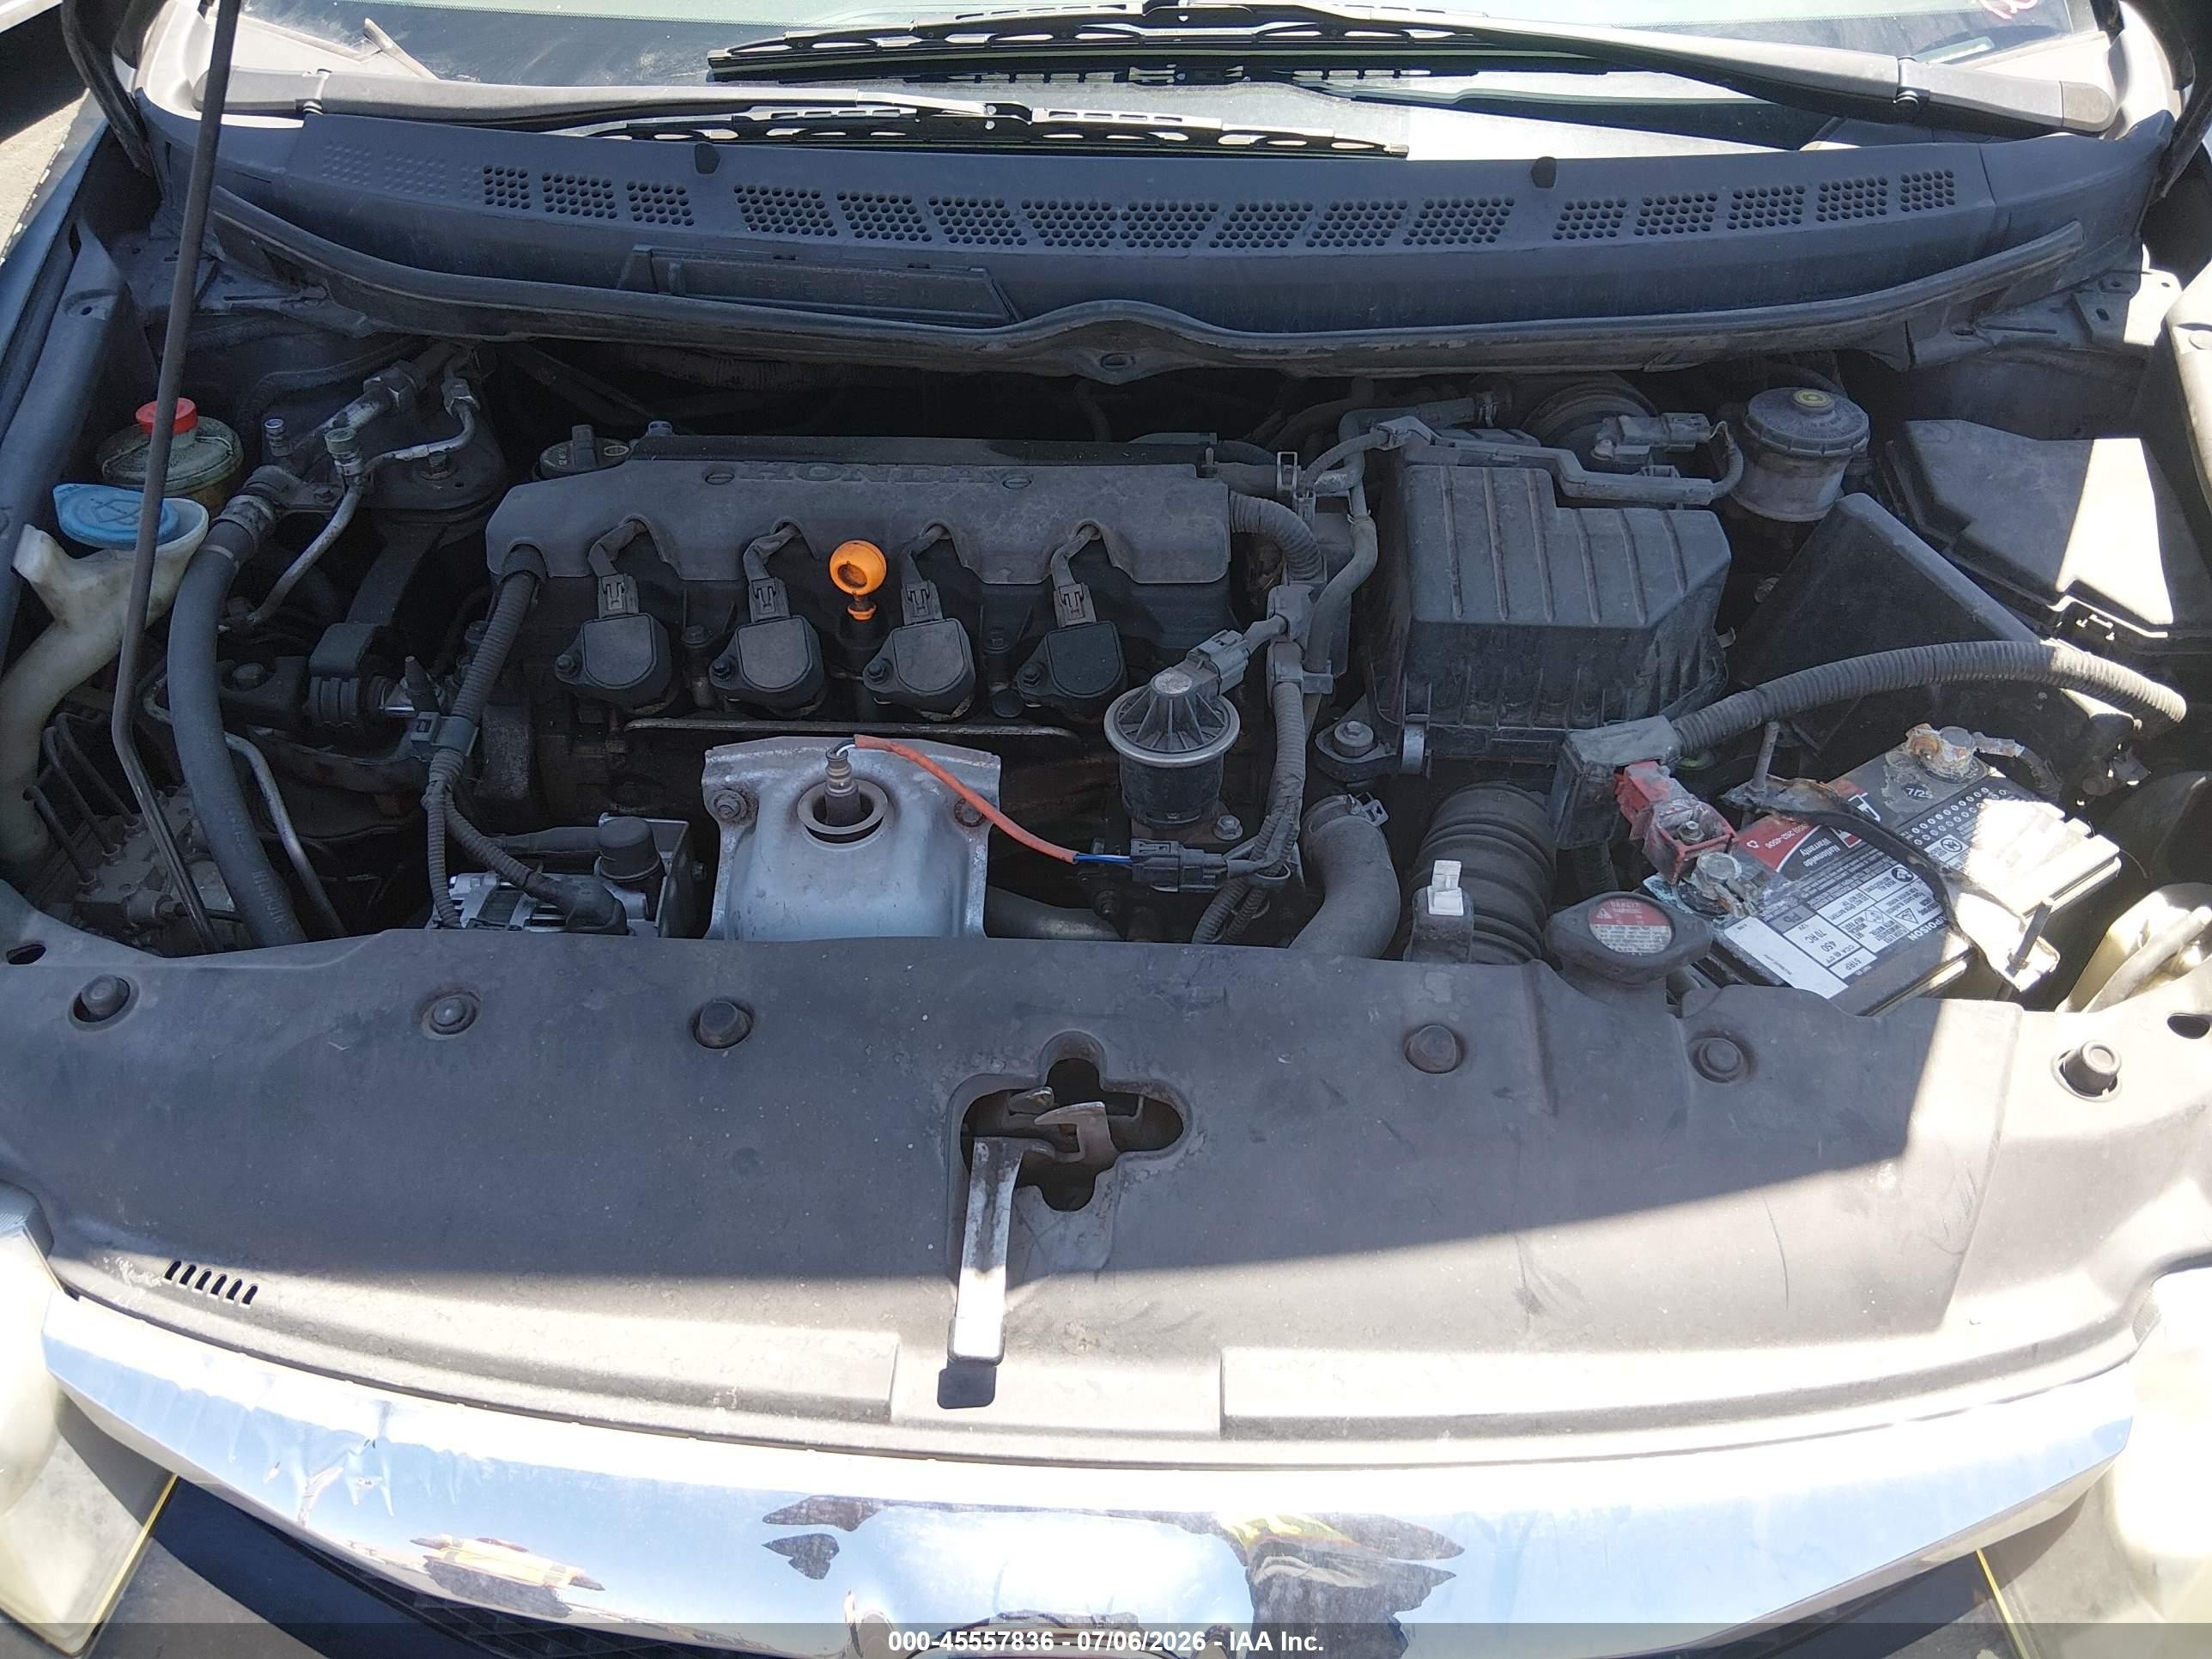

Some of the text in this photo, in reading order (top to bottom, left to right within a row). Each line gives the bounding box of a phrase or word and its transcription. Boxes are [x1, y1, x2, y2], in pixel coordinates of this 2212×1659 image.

[739, 462, 996, 483] HONDA
[1797, 836, 1832, 857] Warranty
[1801, 843, 1841, 868] Nationwide
[1783, 912, 1802, 925] Pb
[1803, 928, 1826, 944] 70 RC
[1819, 939, 1838, 952] 450
